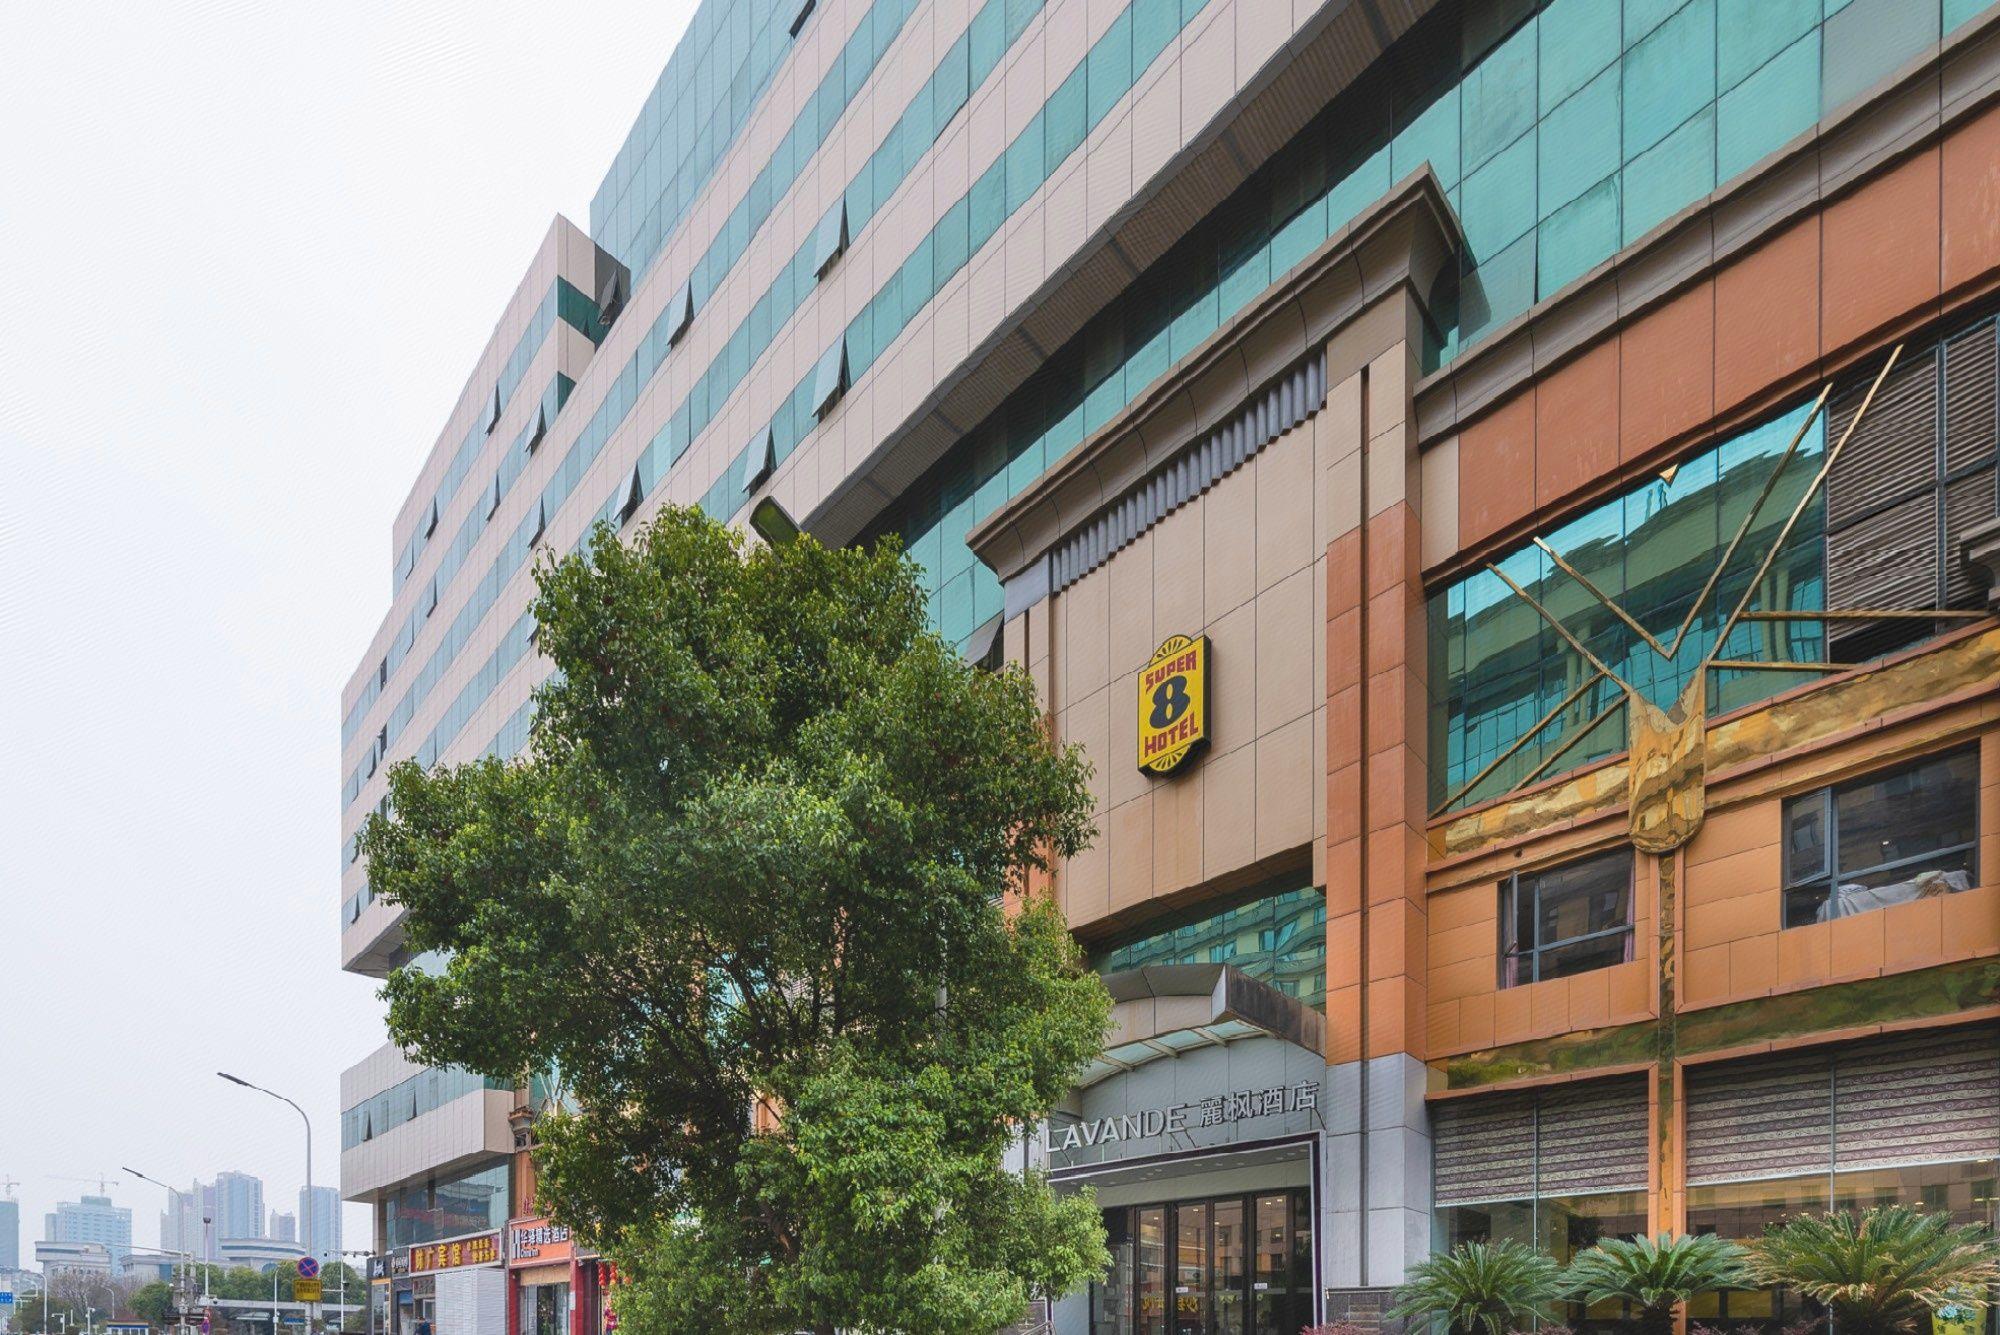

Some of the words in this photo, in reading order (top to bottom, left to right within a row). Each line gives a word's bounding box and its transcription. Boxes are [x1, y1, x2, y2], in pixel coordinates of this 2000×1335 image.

[1145, 650, 1197, 694] SUPER
[1149, 675, 1191, 729] 8
[1145, 711, 1199, 758] HOTEL
[1046, 1105, 1187, 1152] LAVANDE
[1199, 1080, 1320, 1127] 麗枫酒店
